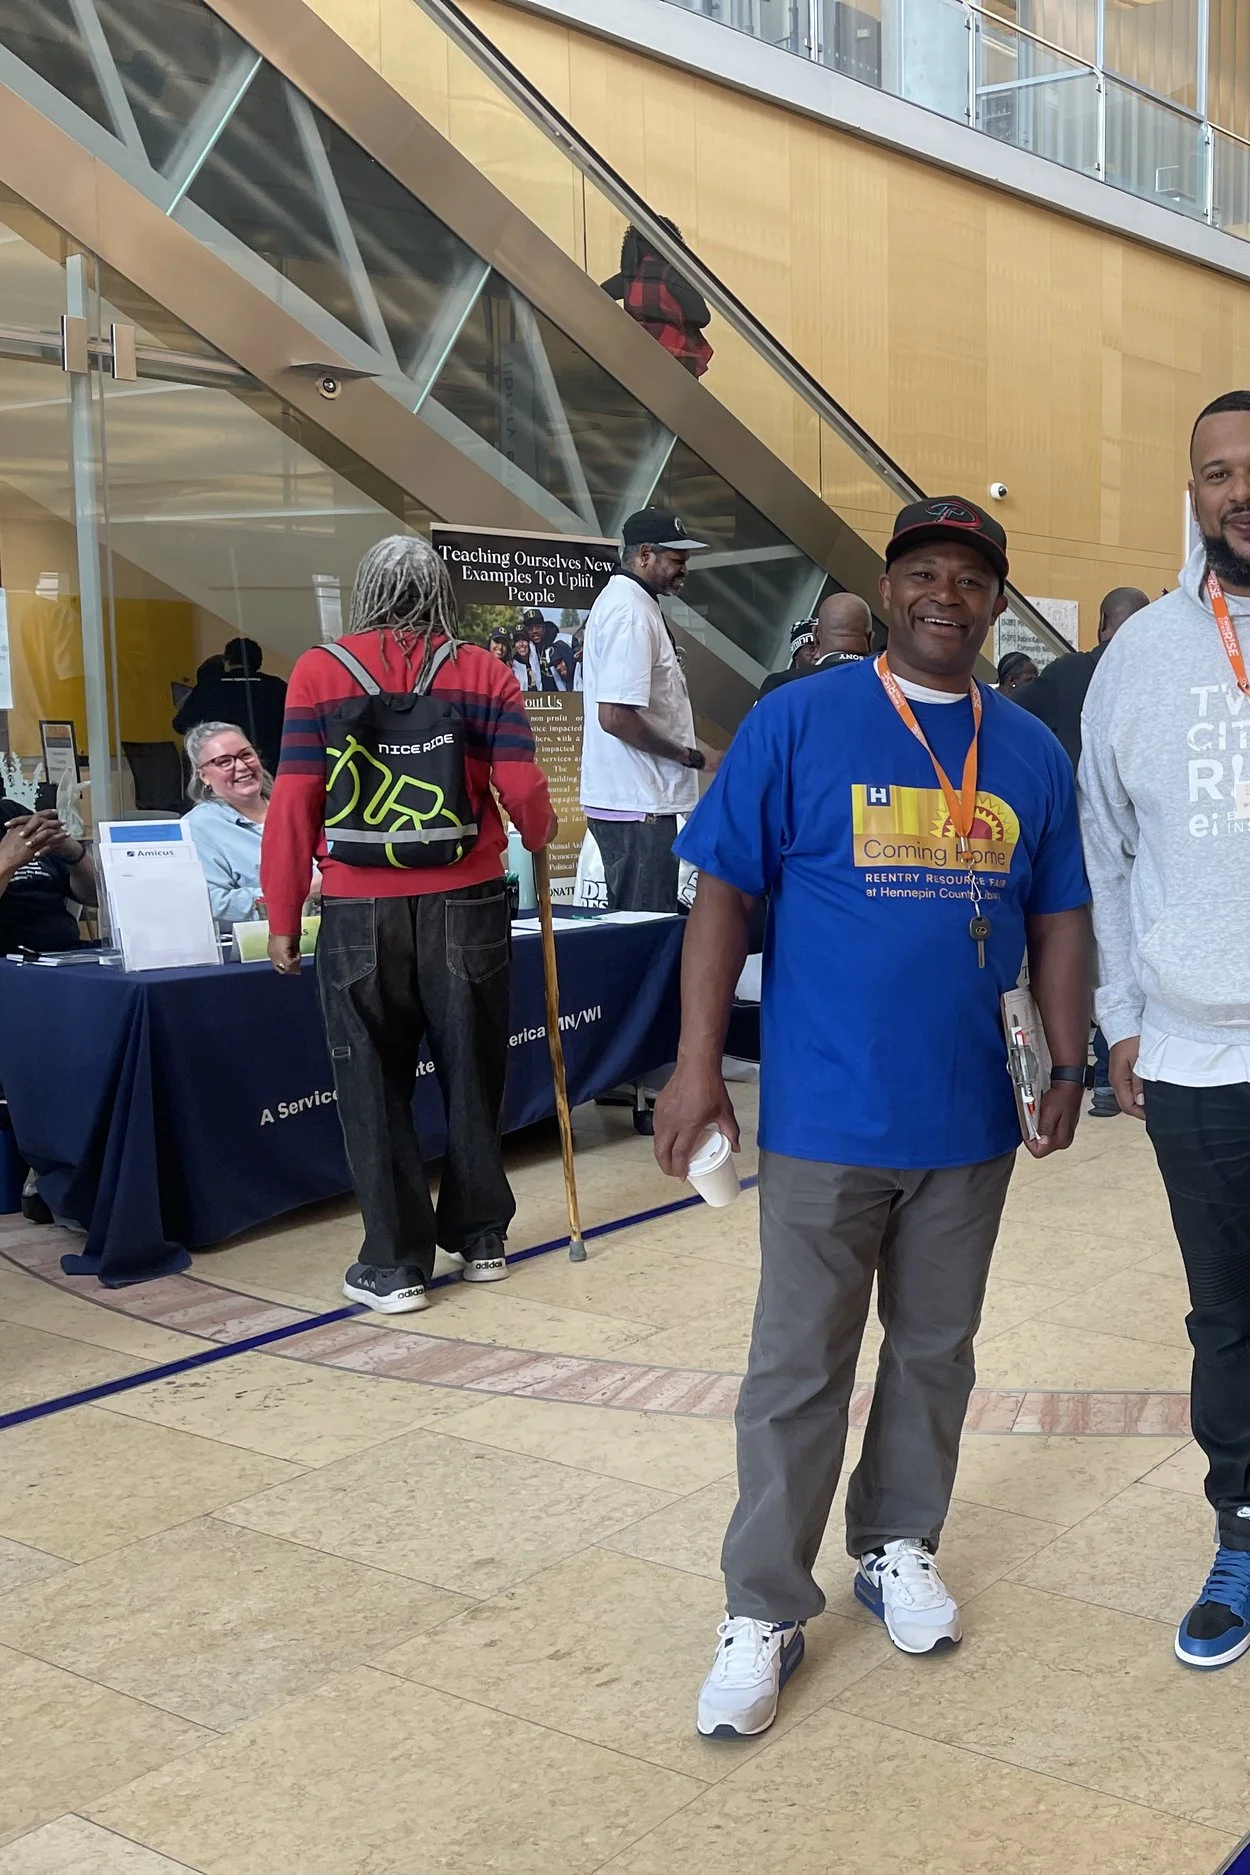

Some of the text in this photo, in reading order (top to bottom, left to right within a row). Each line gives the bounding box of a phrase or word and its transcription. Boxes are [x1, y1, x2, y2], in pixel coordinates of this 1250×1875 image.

[438, 545, 615, 572] Teaching Ourselves New
[462, 565, 594, 590] Examples To Uplift
[508, 586, 556, 606] People
[524, 696, 562, 707] out Us
[546, 714, 568, 723] profit
[550, 725, 582, 733] impacted
[423, 734, 454, 752] RIDE
[542, 745, 574, 754] impacted
[137, 849, 174, 857] Amicus
[864, 840, 947, 866] Coming
[866, 873, 919, 883] REENTRY
[866, 888, 877, 898] at
[880, 887, 936, 900] Hennepin
[508, 1026, 546, 1048] erica
[260, 1108, 274, 1125] A
